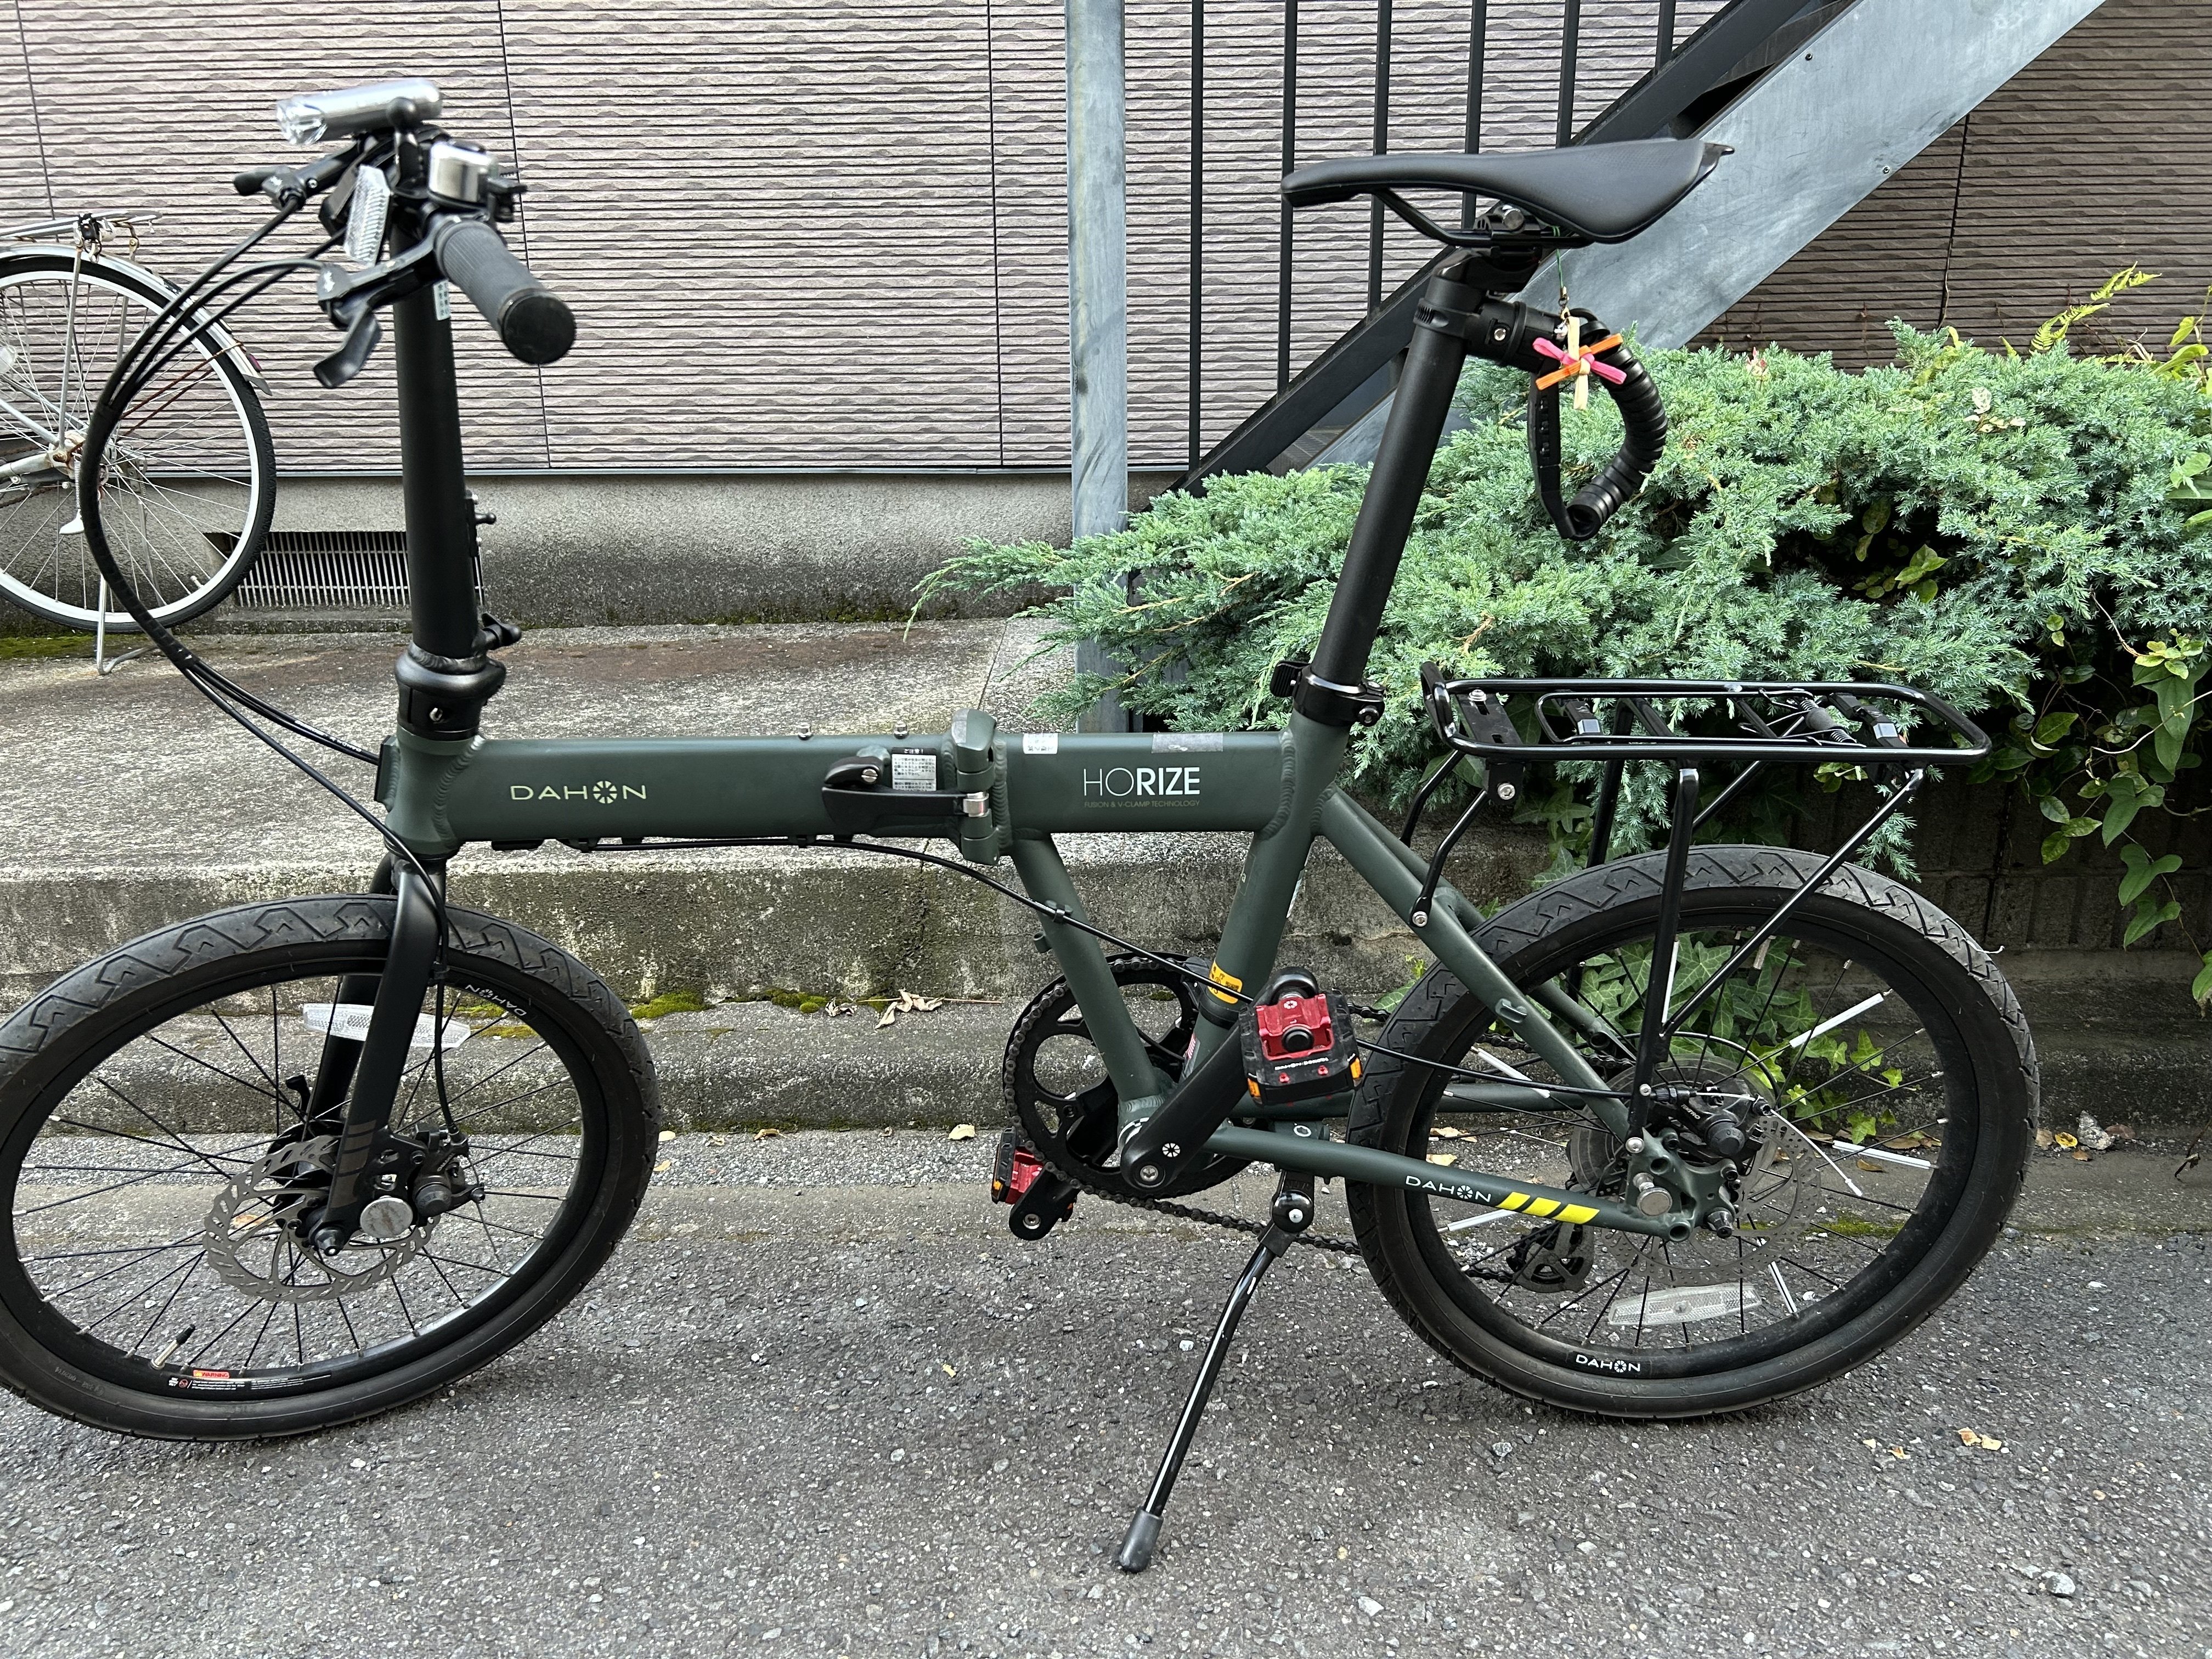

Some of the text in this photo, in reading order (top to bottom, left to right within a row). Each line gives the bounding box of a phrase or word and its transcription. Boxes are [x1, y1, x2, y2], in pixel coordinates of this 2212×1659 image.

[510, 781, 646, 804] DAHON
[1084, 767, 1200, 796] HORIZE
[465, 984, 527, 1016] DAHON
[1406, 1175, 1491, 1203] DAHON
[1576, 1354, 1640, 1373] DAHON
